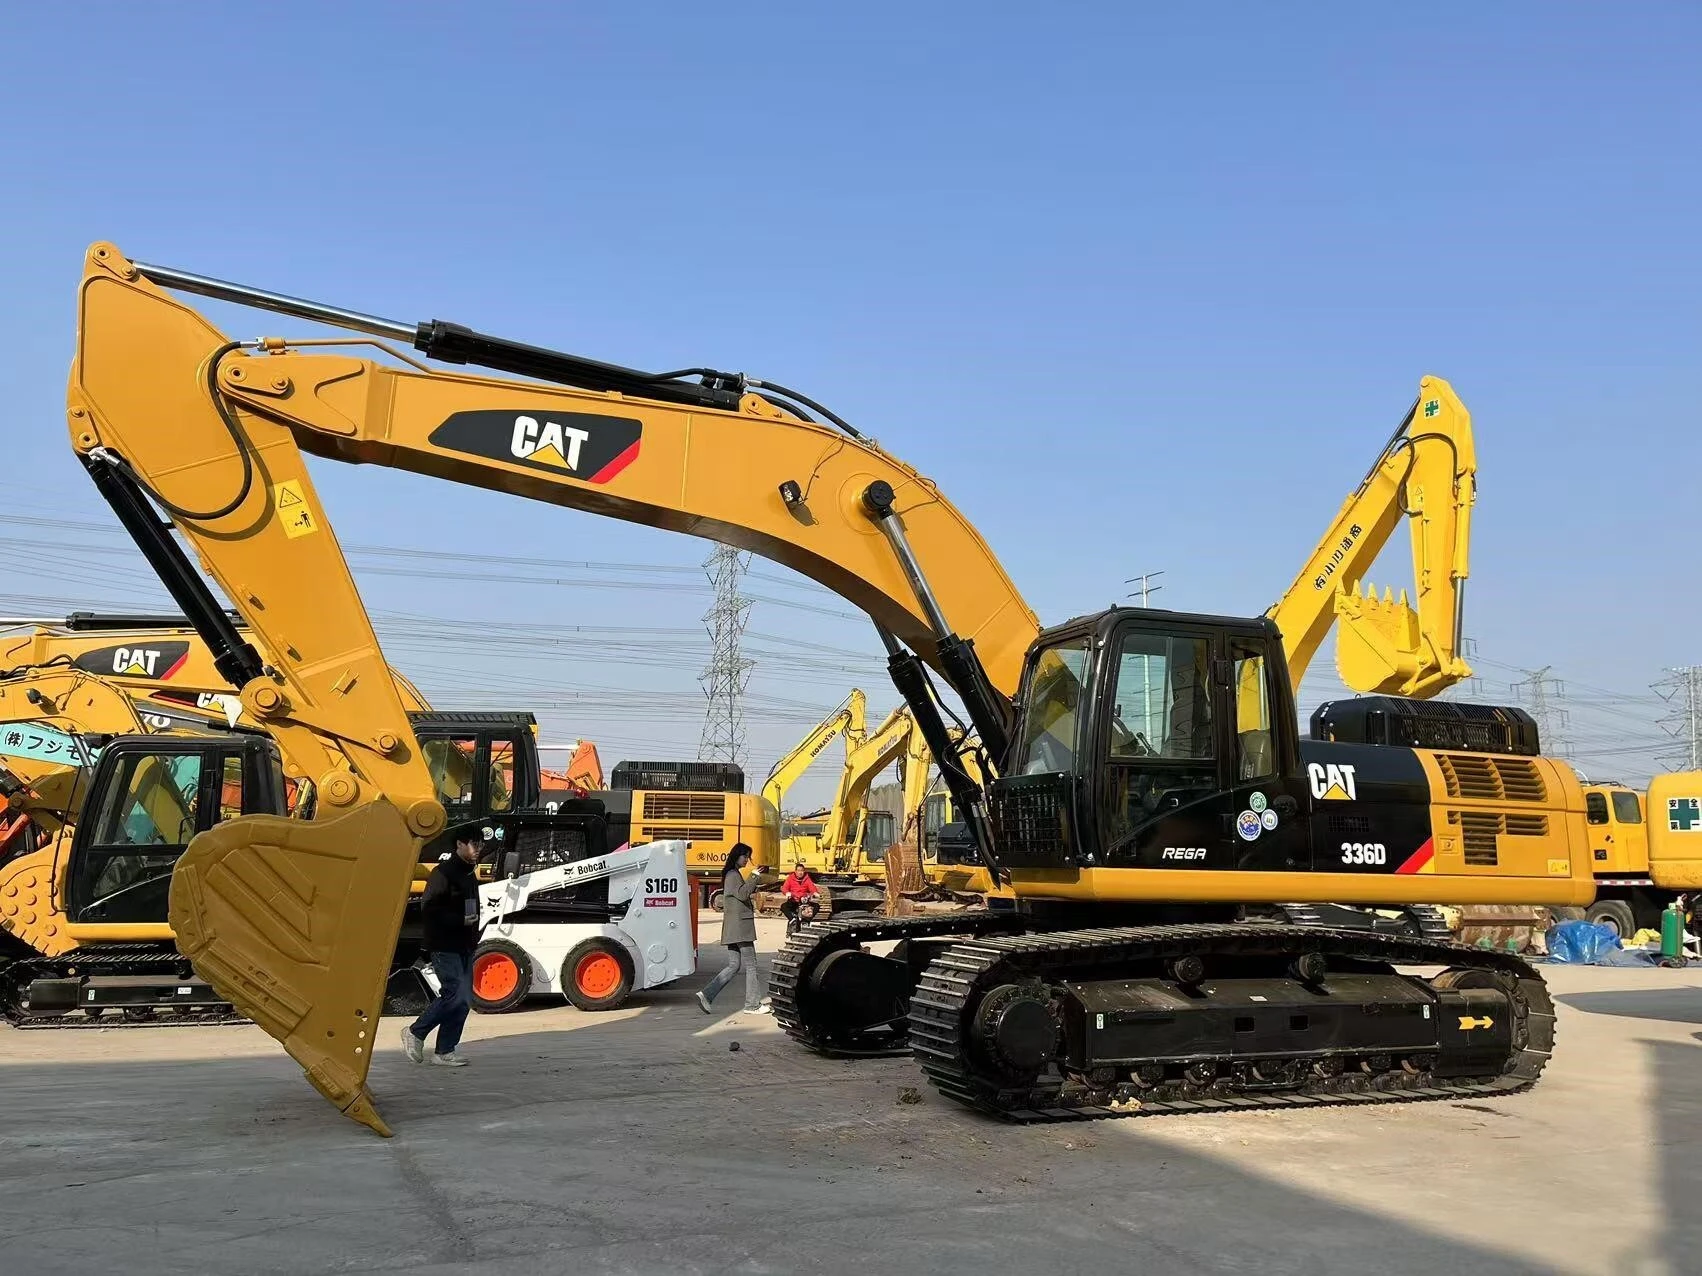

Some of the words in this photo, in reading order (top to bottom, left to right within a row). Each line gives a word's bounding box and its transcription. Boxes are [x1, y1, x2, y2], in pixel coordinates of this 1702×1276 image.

[510, 415, 589, 471] CAT
[112, 648, 160, 676] CAT
[810, 730, 836, 758] KOMATSU
[1307, 762, 1356, 801] CAT
[706, 852, 731, 862] No.0
[1161, 847, 1207, 860] REGA
[1340, 842, 1387, 865] 336D
[577, 860, 607, 875] Bobcat
[645, 878, 678, 893] S160
